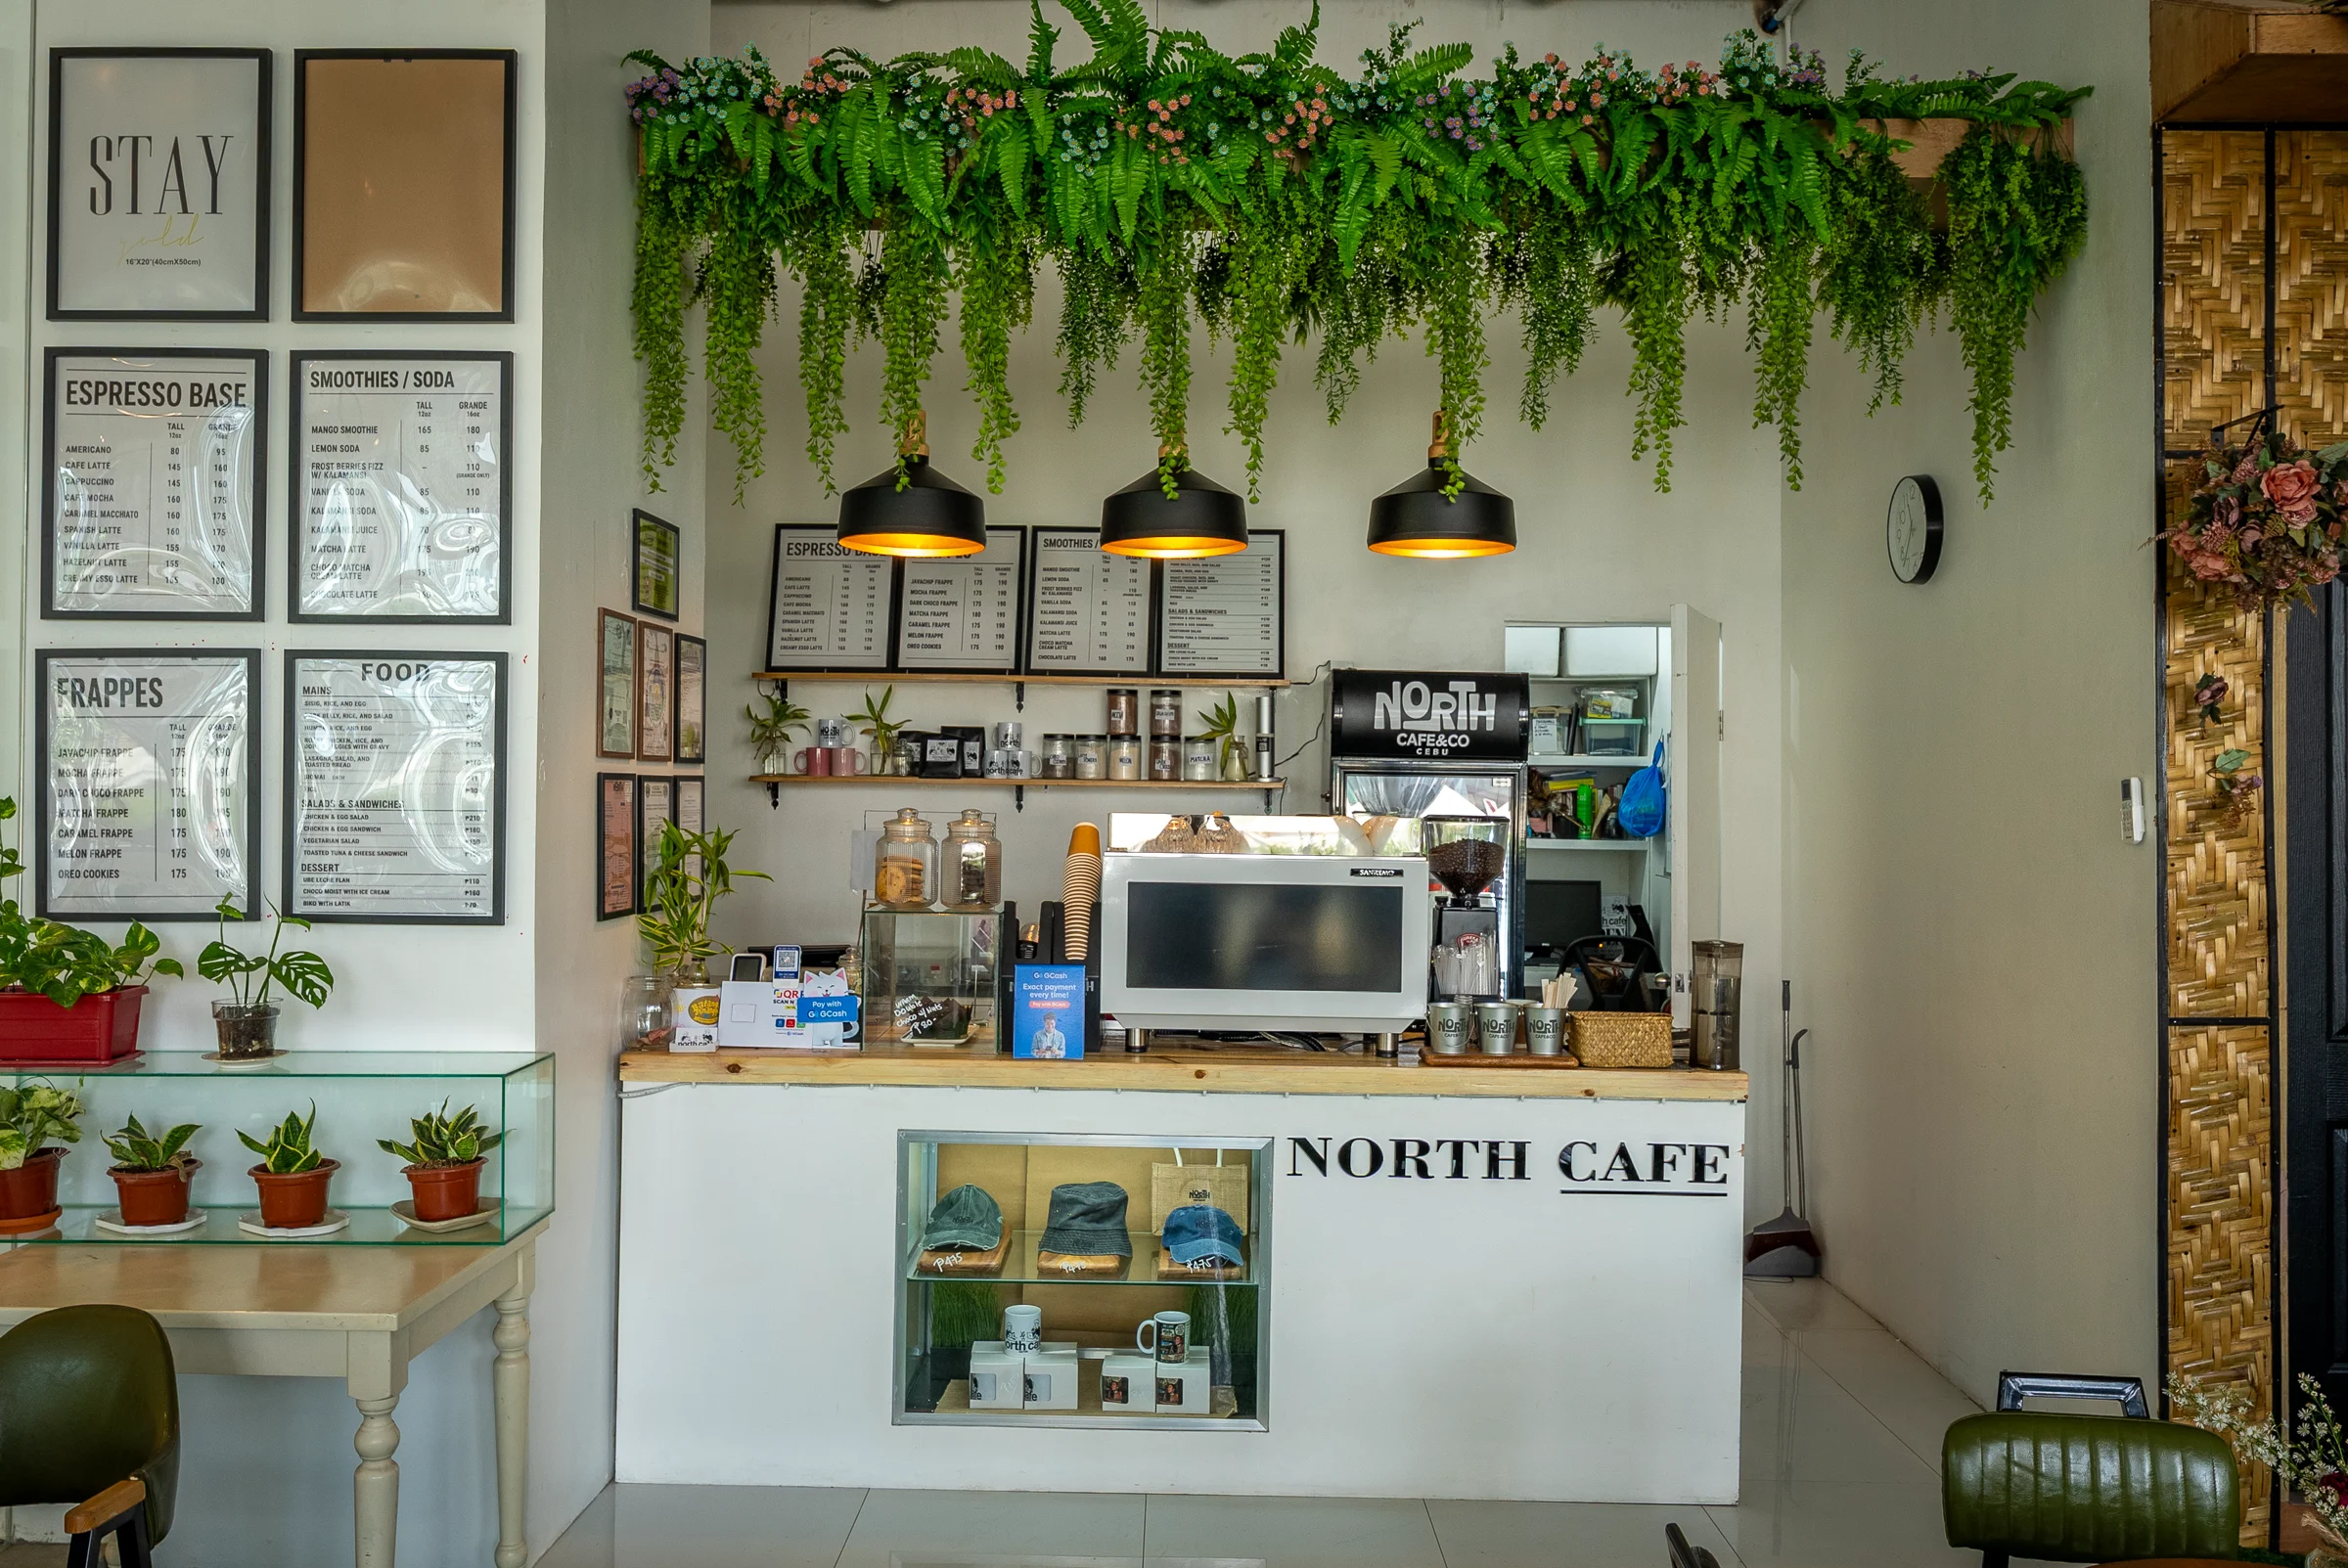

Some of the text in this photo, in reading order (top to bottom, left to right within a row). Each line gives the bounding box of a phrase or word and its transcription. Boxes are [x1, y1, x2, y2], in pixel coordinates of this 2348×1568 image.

[89, 135, 234, 215] STAY
[310, 371, 454, 388] SMOOTHIES / SODA
[66, 381, 247, 408] ESPRESSO BASE
[787, 543, 851, 556] ESPRESSO
[1043, 539, 1093, 548] SMOOTHIES
[361, 663, 430, 682] FOOD
[57, 678, 163, 708] FRAPPES
[1374, 681, 1497, 732] NORTH
[1397, 734, 1469, 747] CAFE&CO
[113, 788, 187, 797] FRAPPE 175
[96, 809, 186, 818] FRAPPE 180
[58, 829, 98, 838] CARAMEL
[58, 849, 230, 858] MELON FRAPPE 175 190
[58, 870, 81, 878] OREO
[83, 870, 119, 878] COOKIES
[784, 990, 798, 999] QR
[1483, 1019, 1514, 1033] NORTH
[1529, 1019, 1560, 1033] NORTH
[1287, 1136, 1730, 1184] NORTH CAFE
[1006, 1341, 1025, 1351] orth
